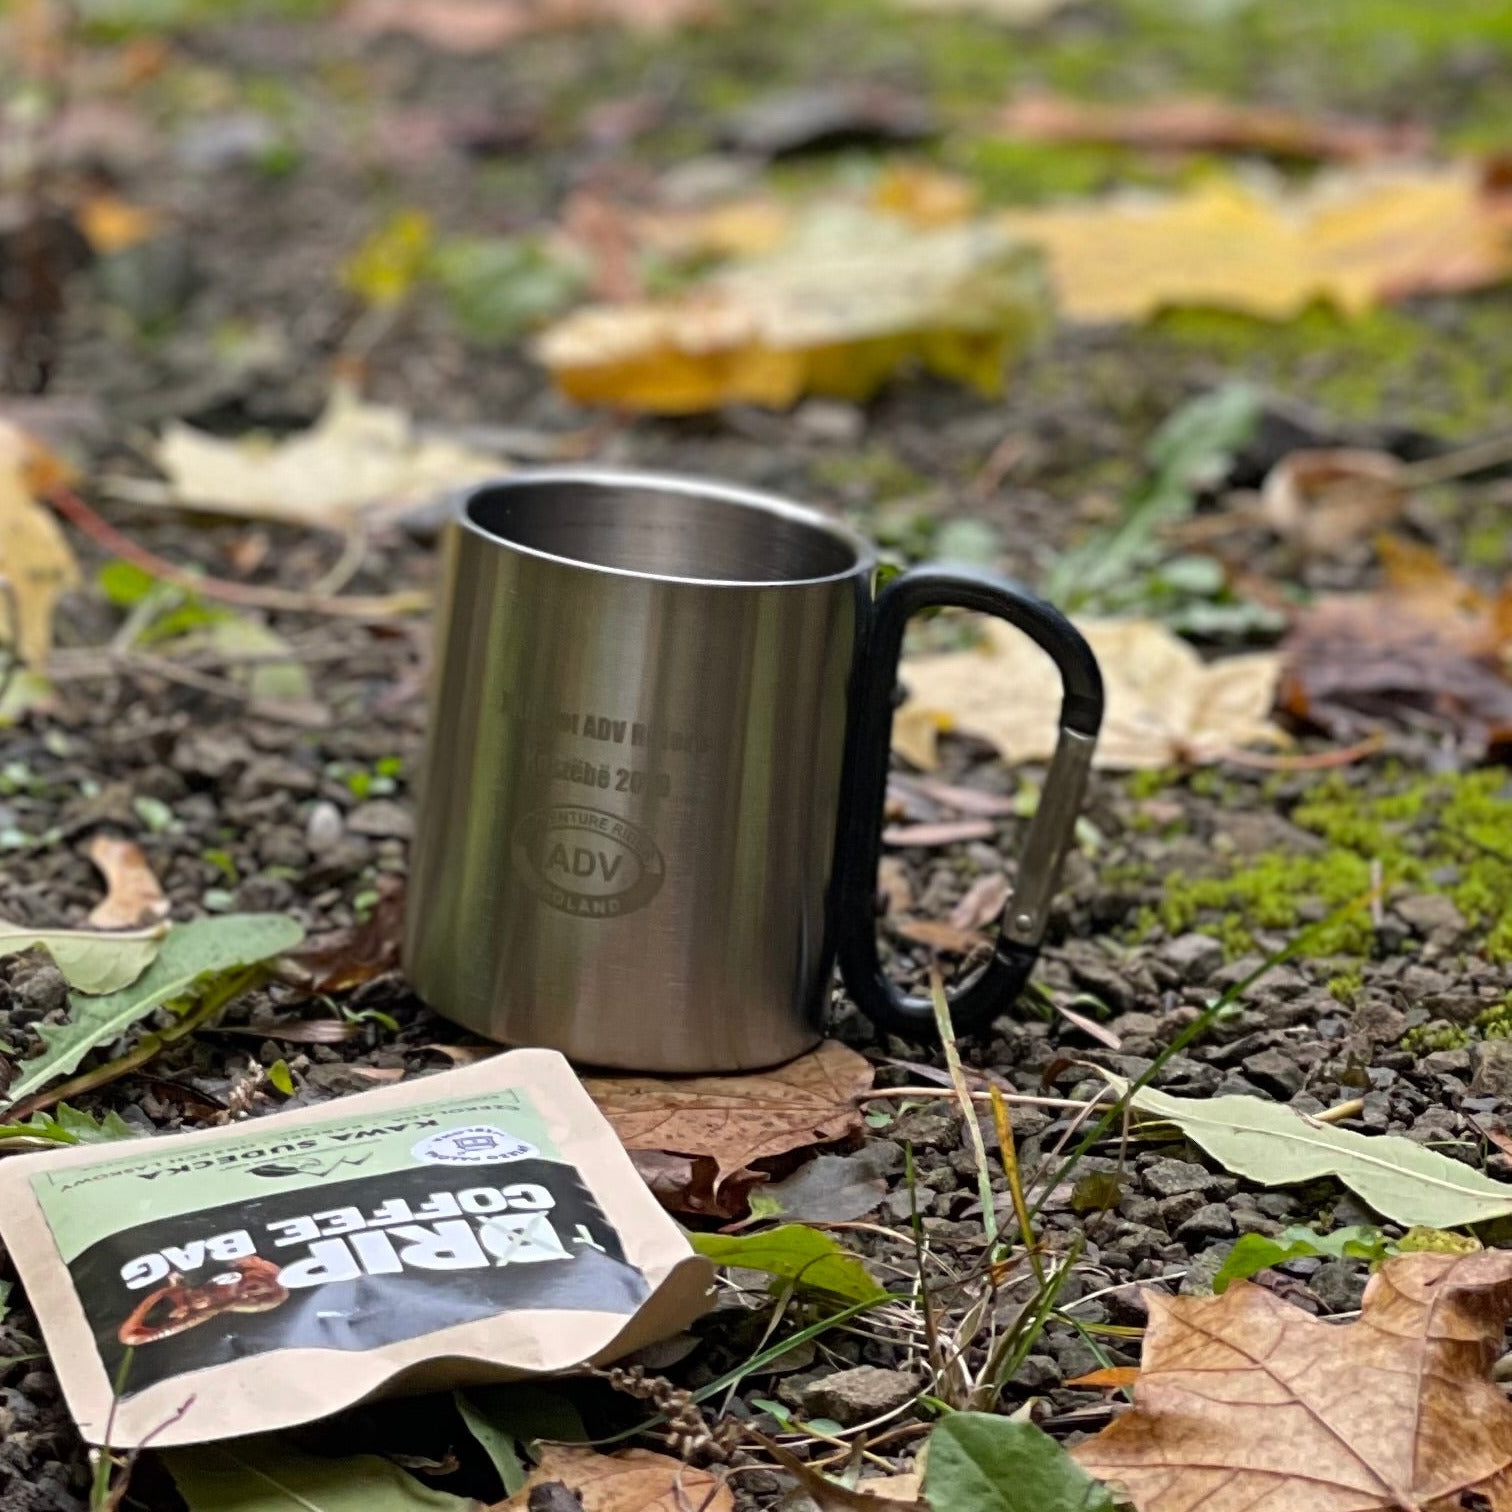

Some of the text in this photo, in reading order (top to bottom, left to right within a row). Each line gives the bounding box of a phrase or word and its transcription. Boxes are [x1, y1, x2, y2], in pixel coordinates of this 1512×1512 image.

[583, 714, 627, 744] ADV
[548, 843, 624, 882] ADV
[328, 1120, 440, 1142] KAWA
[136, 1140, 318, 1181] SUDECKA
[118, 1182, 557, 1291] COFFEE BAG
[276, 1211, 576, 1289] DRIP
